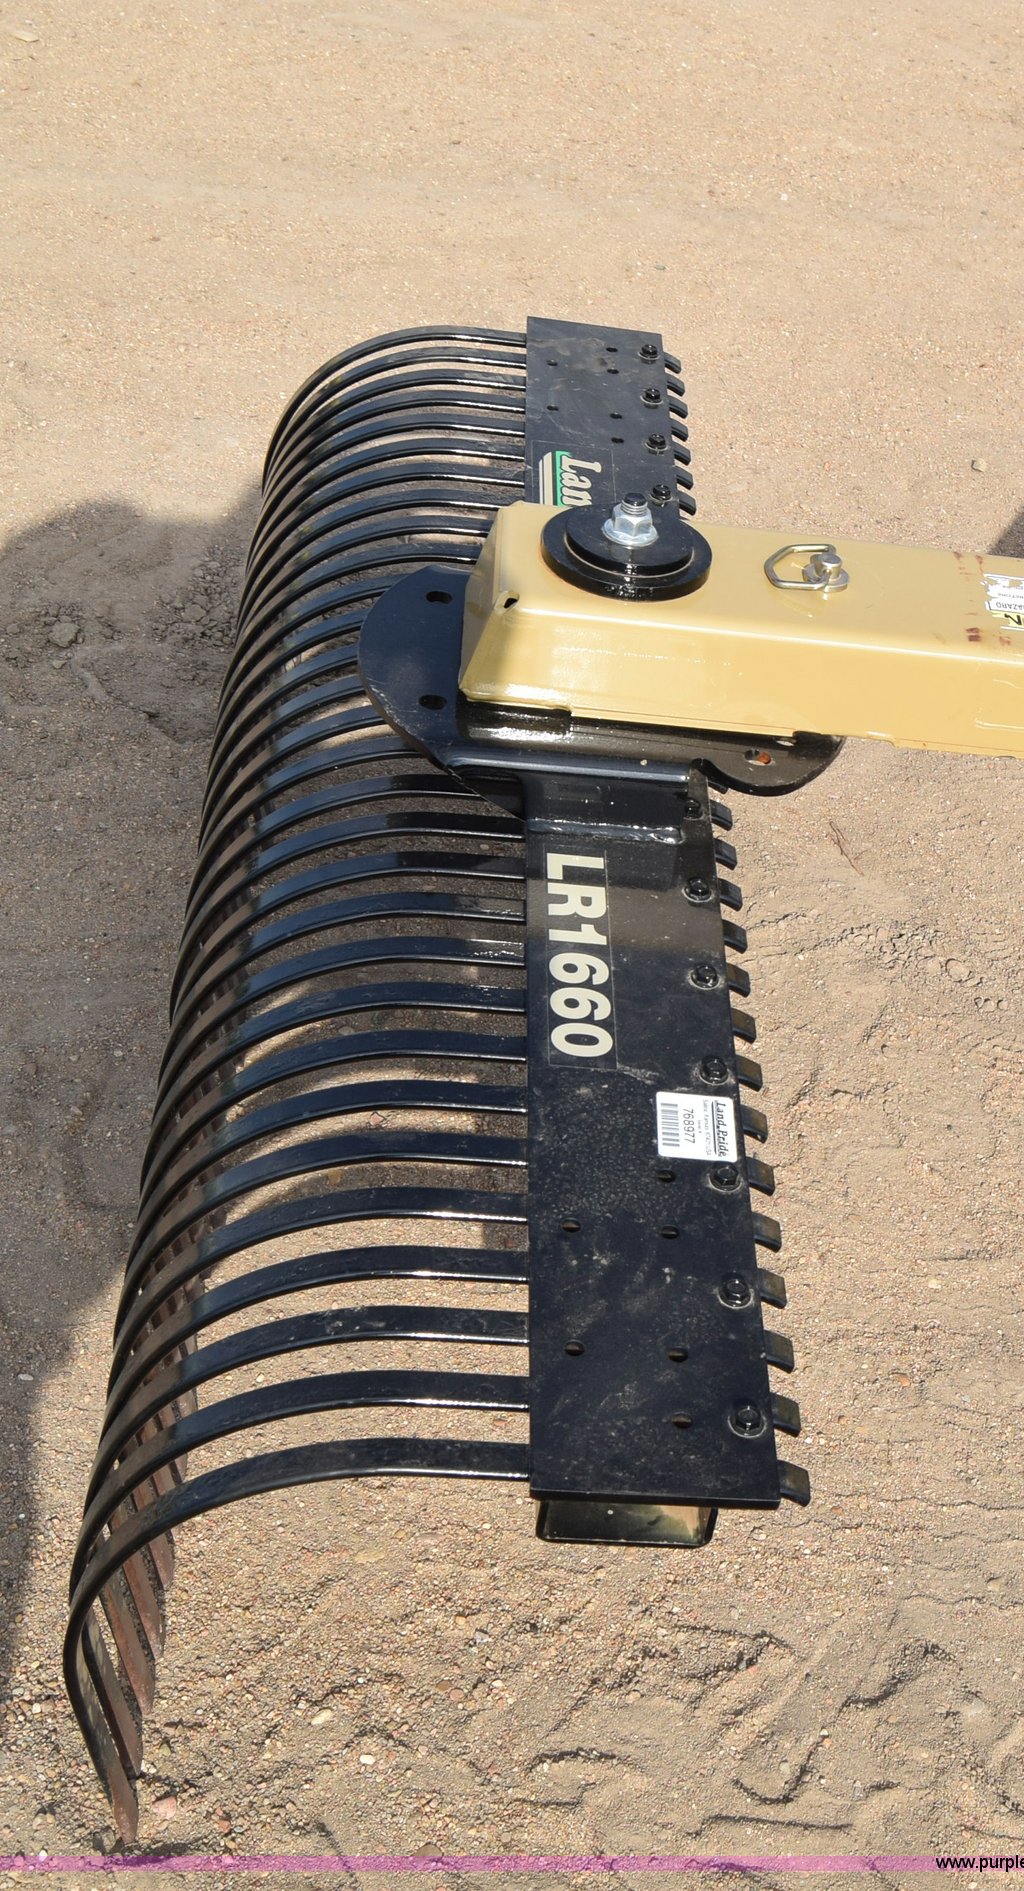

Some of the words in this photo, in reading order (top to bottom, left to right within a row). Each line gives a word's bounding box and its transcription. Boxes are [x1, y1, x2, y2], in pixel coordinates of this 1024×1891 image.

[561, 455, 602, 507] Lan
[546, 852, 614, 1058] LR1660
[683, 1108, 696, 1144] 768977
[717, 1102, 727, 1127] Land
[718, 1129, 729, 1156] Pride
